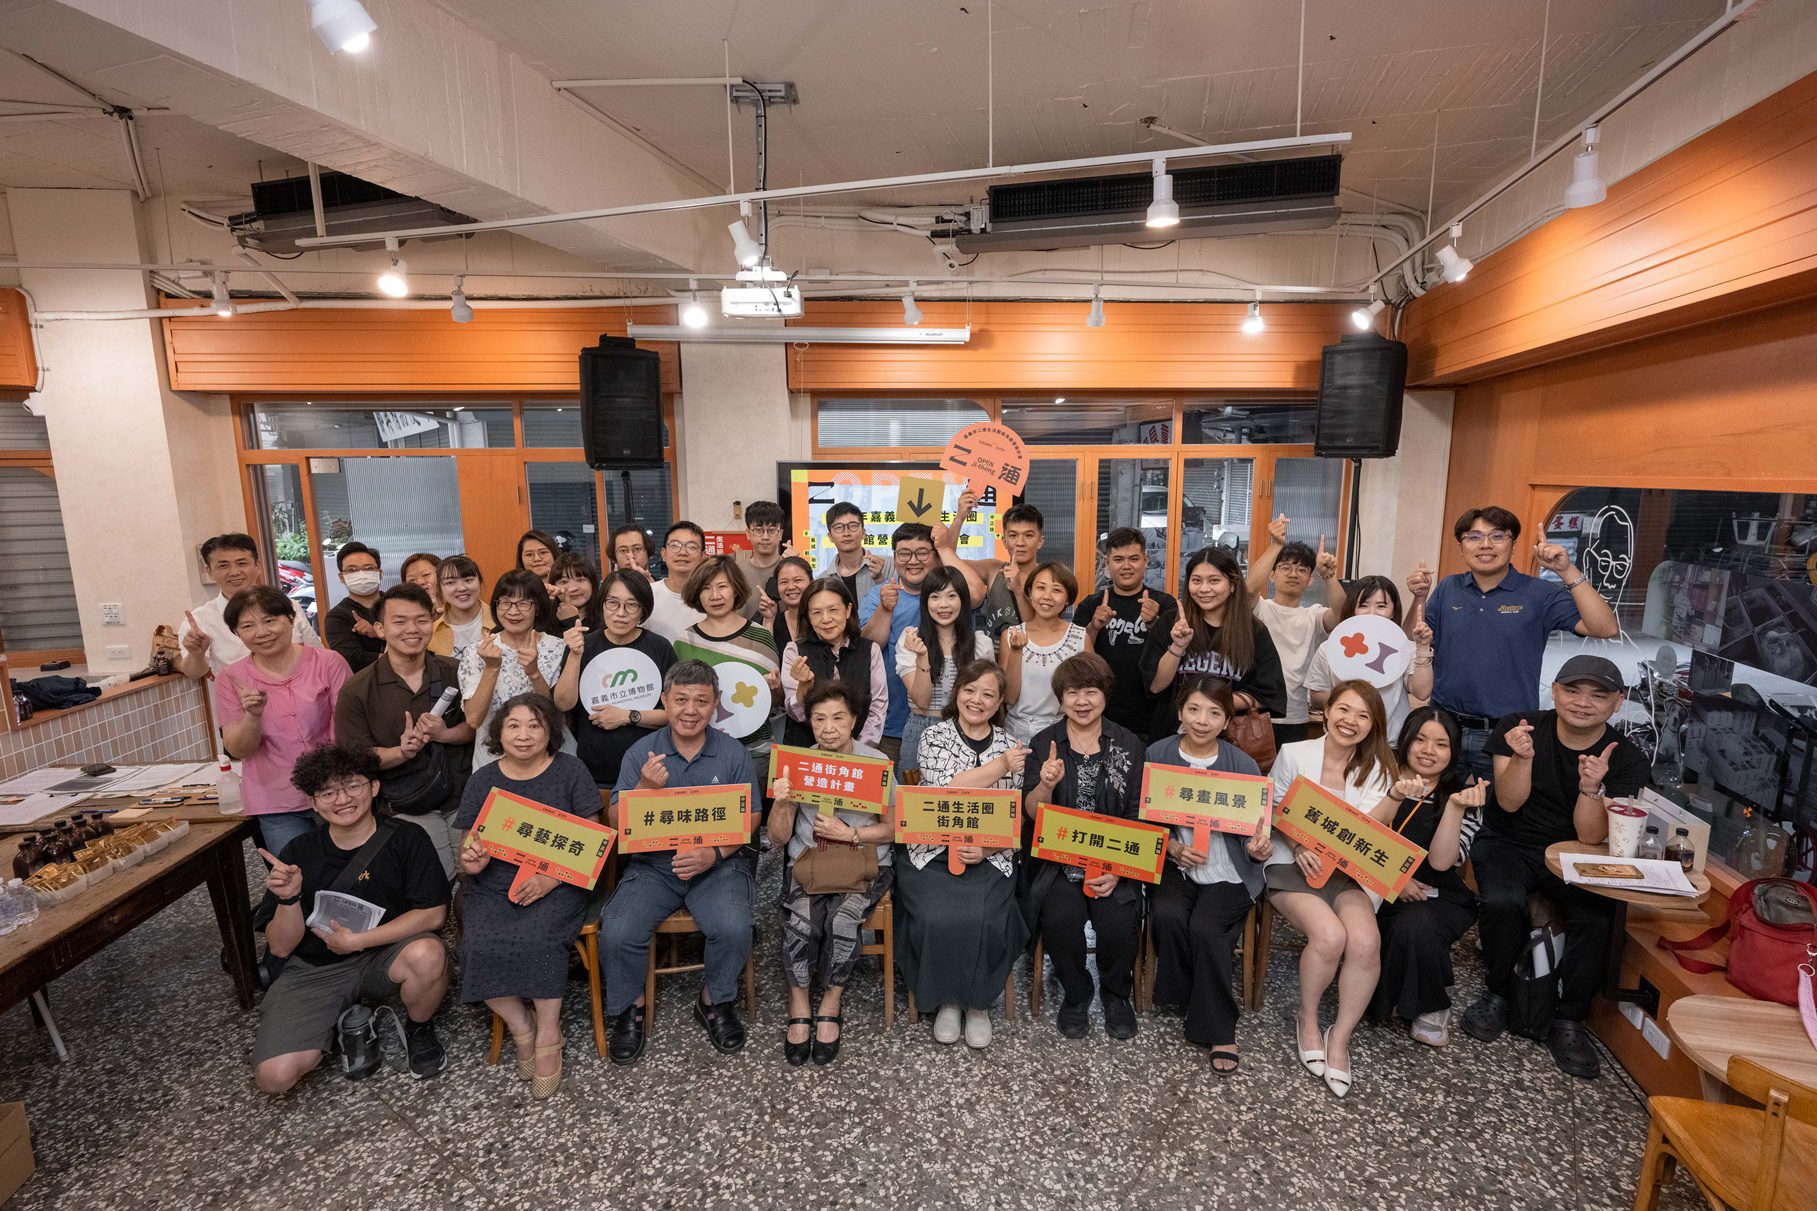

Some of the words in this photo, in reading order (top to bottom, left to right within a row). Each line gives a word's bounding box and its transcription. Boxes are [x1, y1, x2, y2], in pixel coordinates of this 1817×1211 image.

[971, 461, 996, 476] Ji-thong
[977, 457, 995, 467] OPEN
[1552, 515, 1580, 530] 蛋糕
[1179, 651, 1243, 682] EGEN
[591, 683, 655, 705] 嘉義市立博物館
[798, 761, 864, 780] 二通街角館
[803, 775, 856, 793] 營造計畫
[1164, 785, 1248, 809] #尋畫風景
[643, 807, 727, 827] #尋味路徑
[922, 800, 994, 815] 二通生活圈
[937, 815, 980, 829] 街角館
[501, 817, 586, 857] #尋藝探奇
[1057, 826, 1140, 856] #打開二通
[1303, 805, 1389, 868] 舊城創新生
